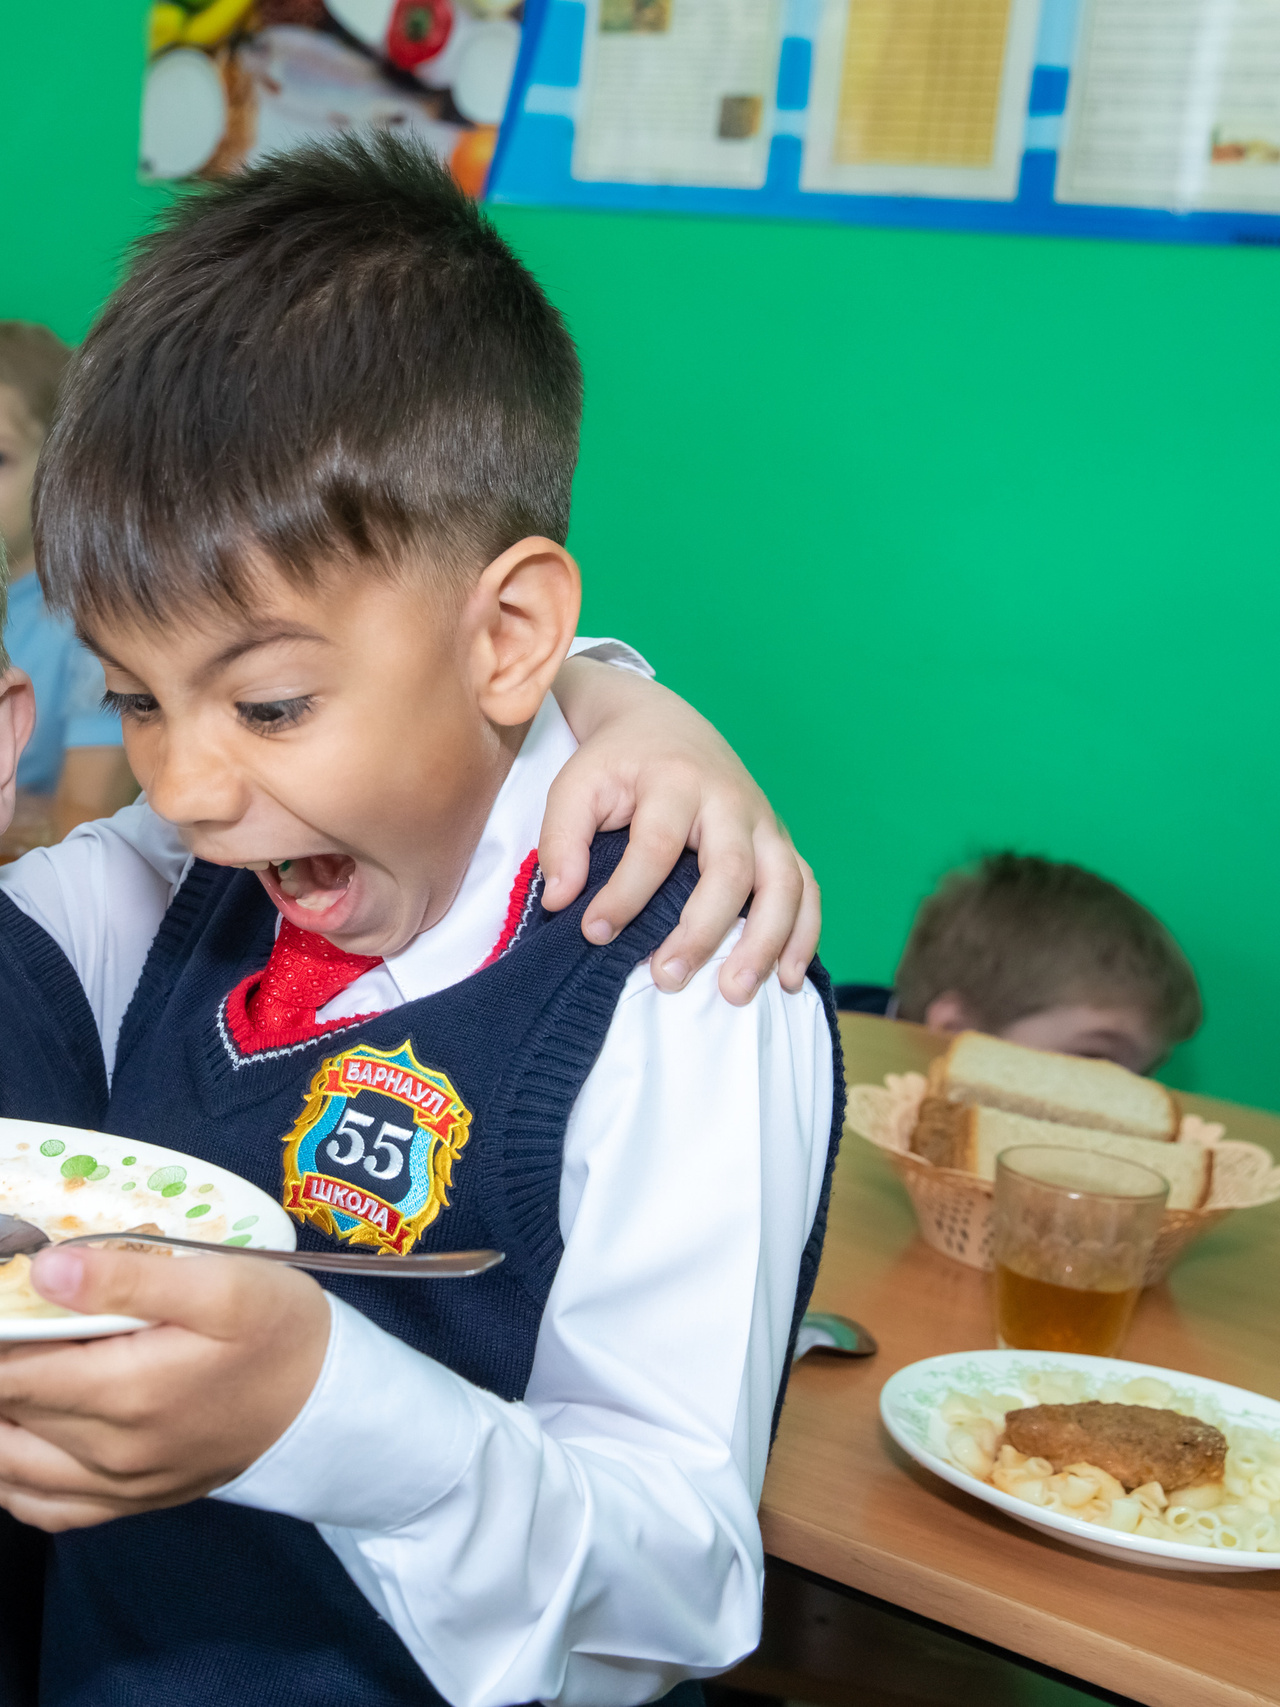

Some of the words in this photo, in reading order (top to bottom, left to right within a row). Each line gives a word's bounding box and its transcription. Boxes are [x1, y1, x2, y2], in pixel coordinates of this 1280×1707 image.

[346, 1061, 446, 1115] БАРНАУЛ
[326, 1108, 414, 1180] 55
[310, 1178, 389, 1232] ШКОЛА
